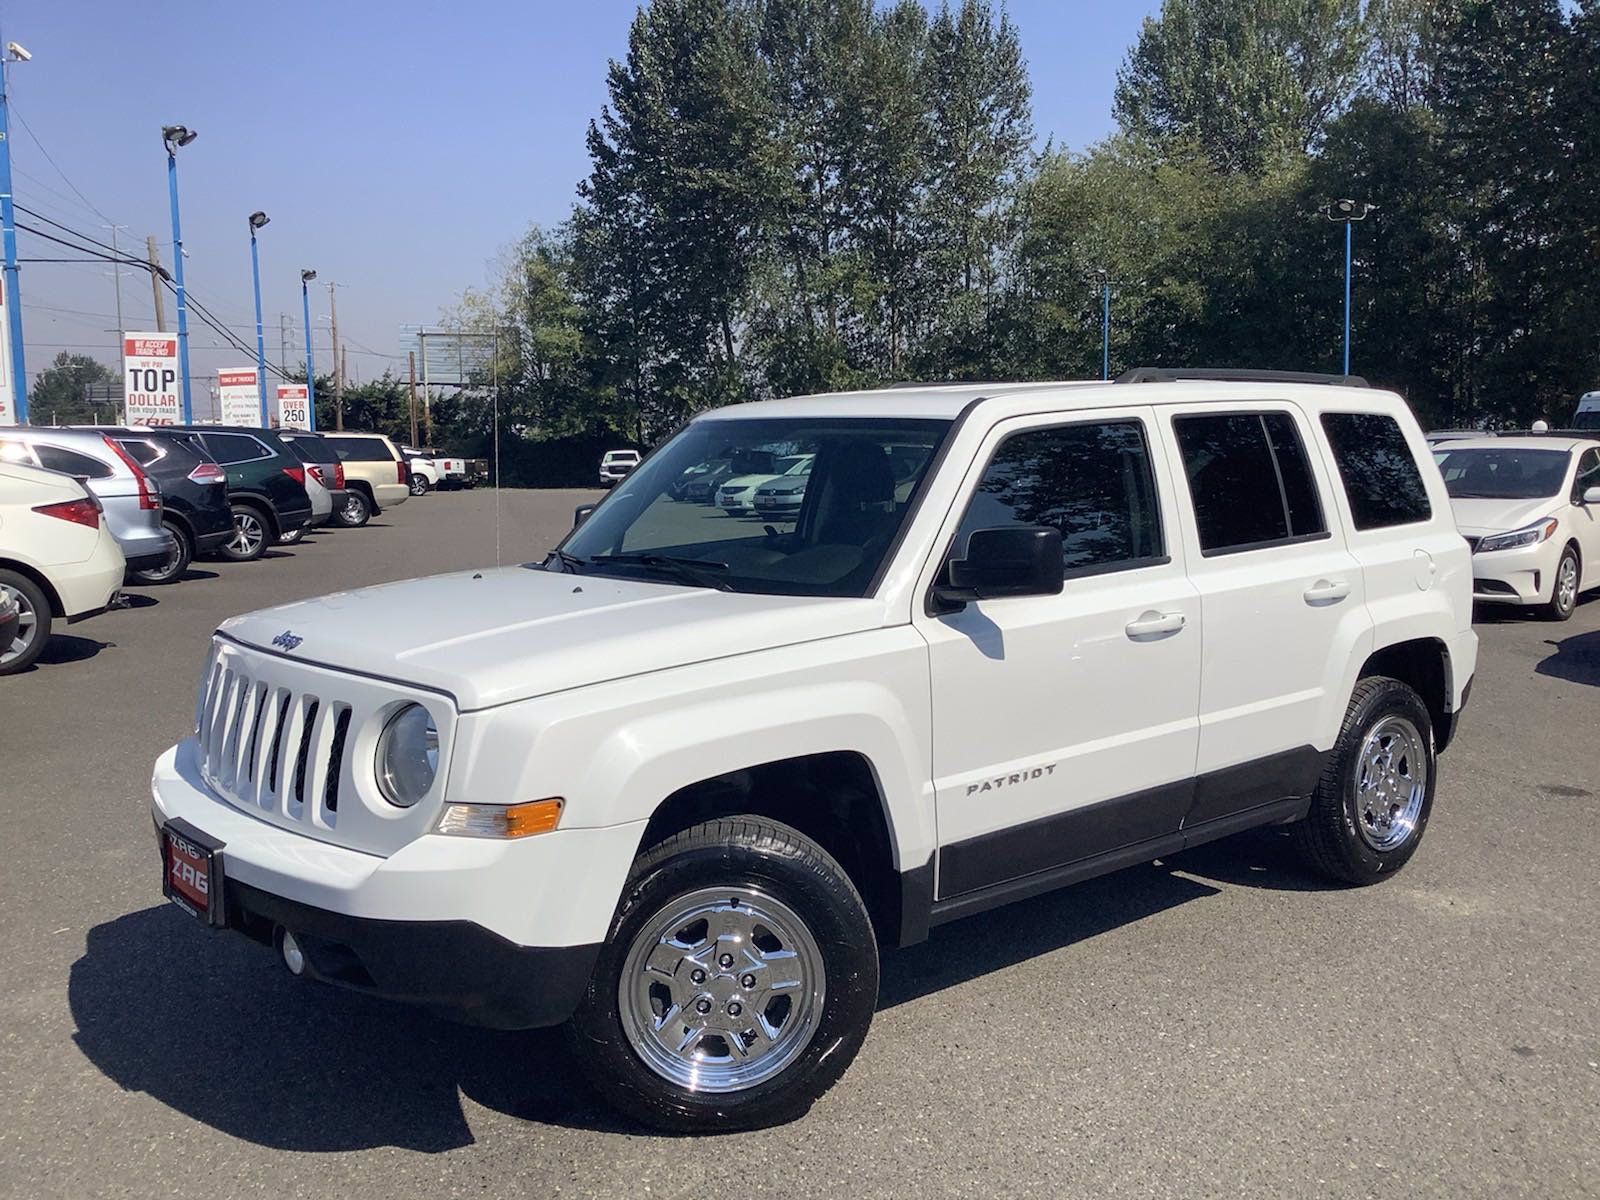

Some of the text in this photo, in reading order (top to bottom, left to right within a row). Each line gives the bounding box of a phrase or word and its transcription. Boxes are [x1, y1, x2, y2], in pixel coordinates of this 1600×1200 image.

[129, 368, 175, 392] TOP
[129, 394, 176, 407] DOLLAR
[283, 401, 305, 409] OVER
[284, 409, 305, 422] 250
[966, 763, 1056, 796] PATRIOT
[171, 855, 208, 895] ZAG
